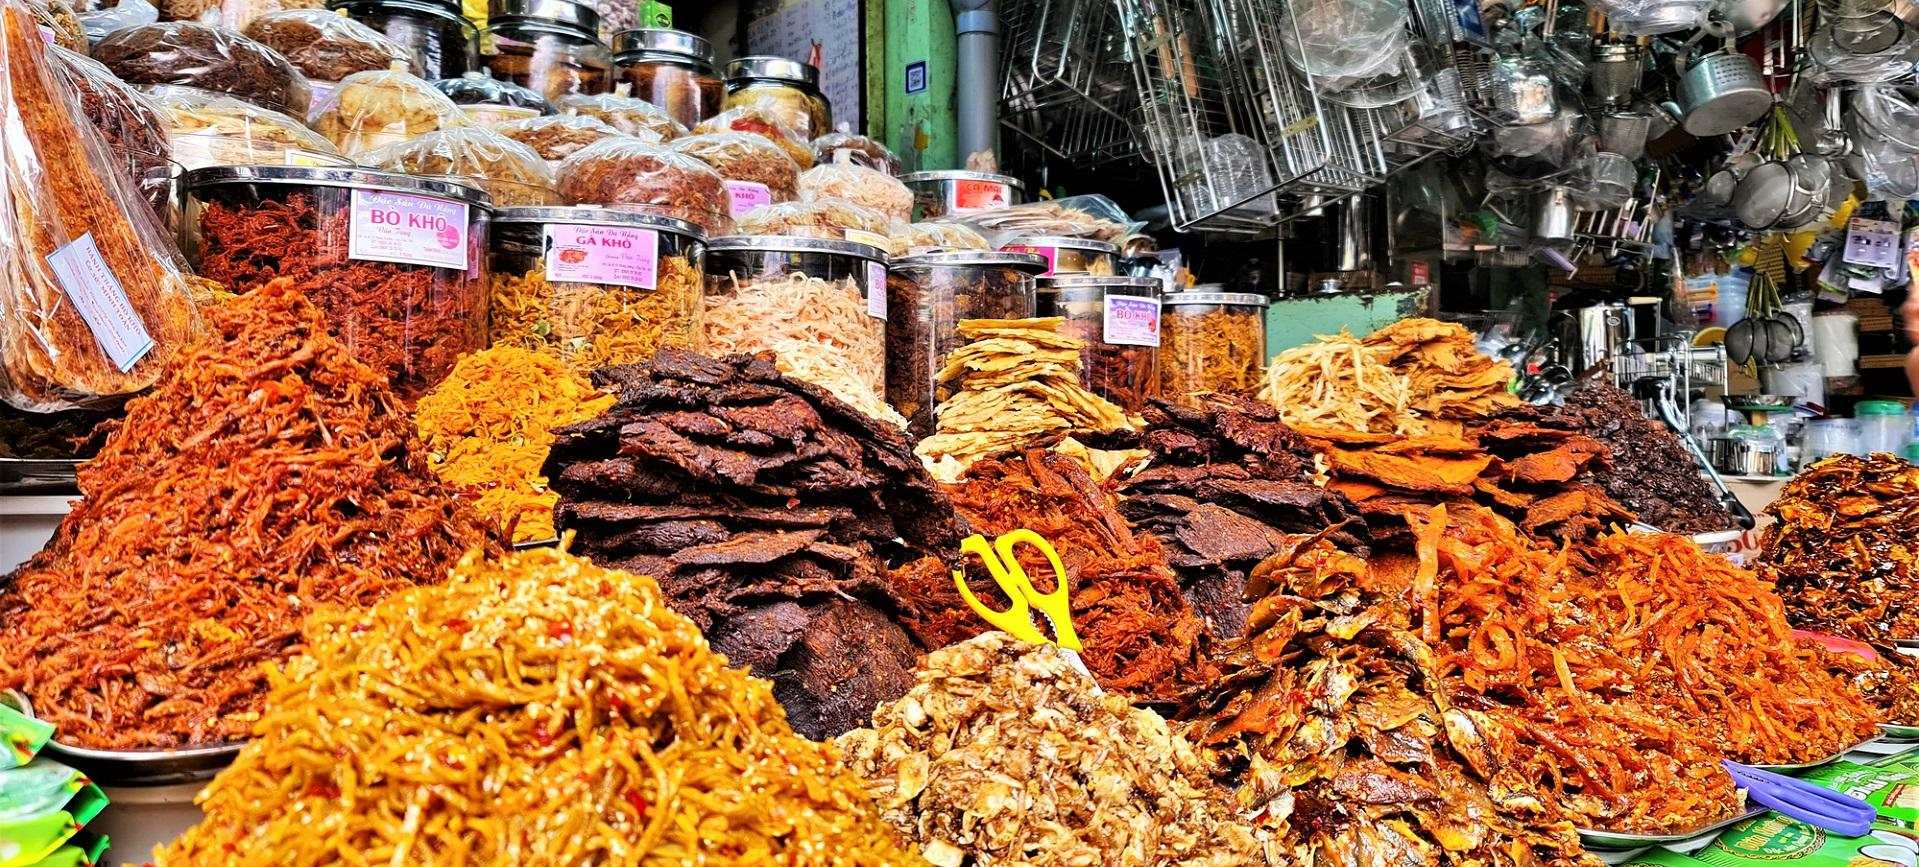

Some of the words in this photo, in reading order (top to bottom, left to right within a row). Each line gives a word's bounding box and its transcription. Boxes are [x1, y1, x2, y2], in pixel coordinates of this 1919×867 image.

[370, 205, 400, 226] BÒ
[408, 211, 447, 232] KHÔ
[576, 234, 597, 247] GÀ
